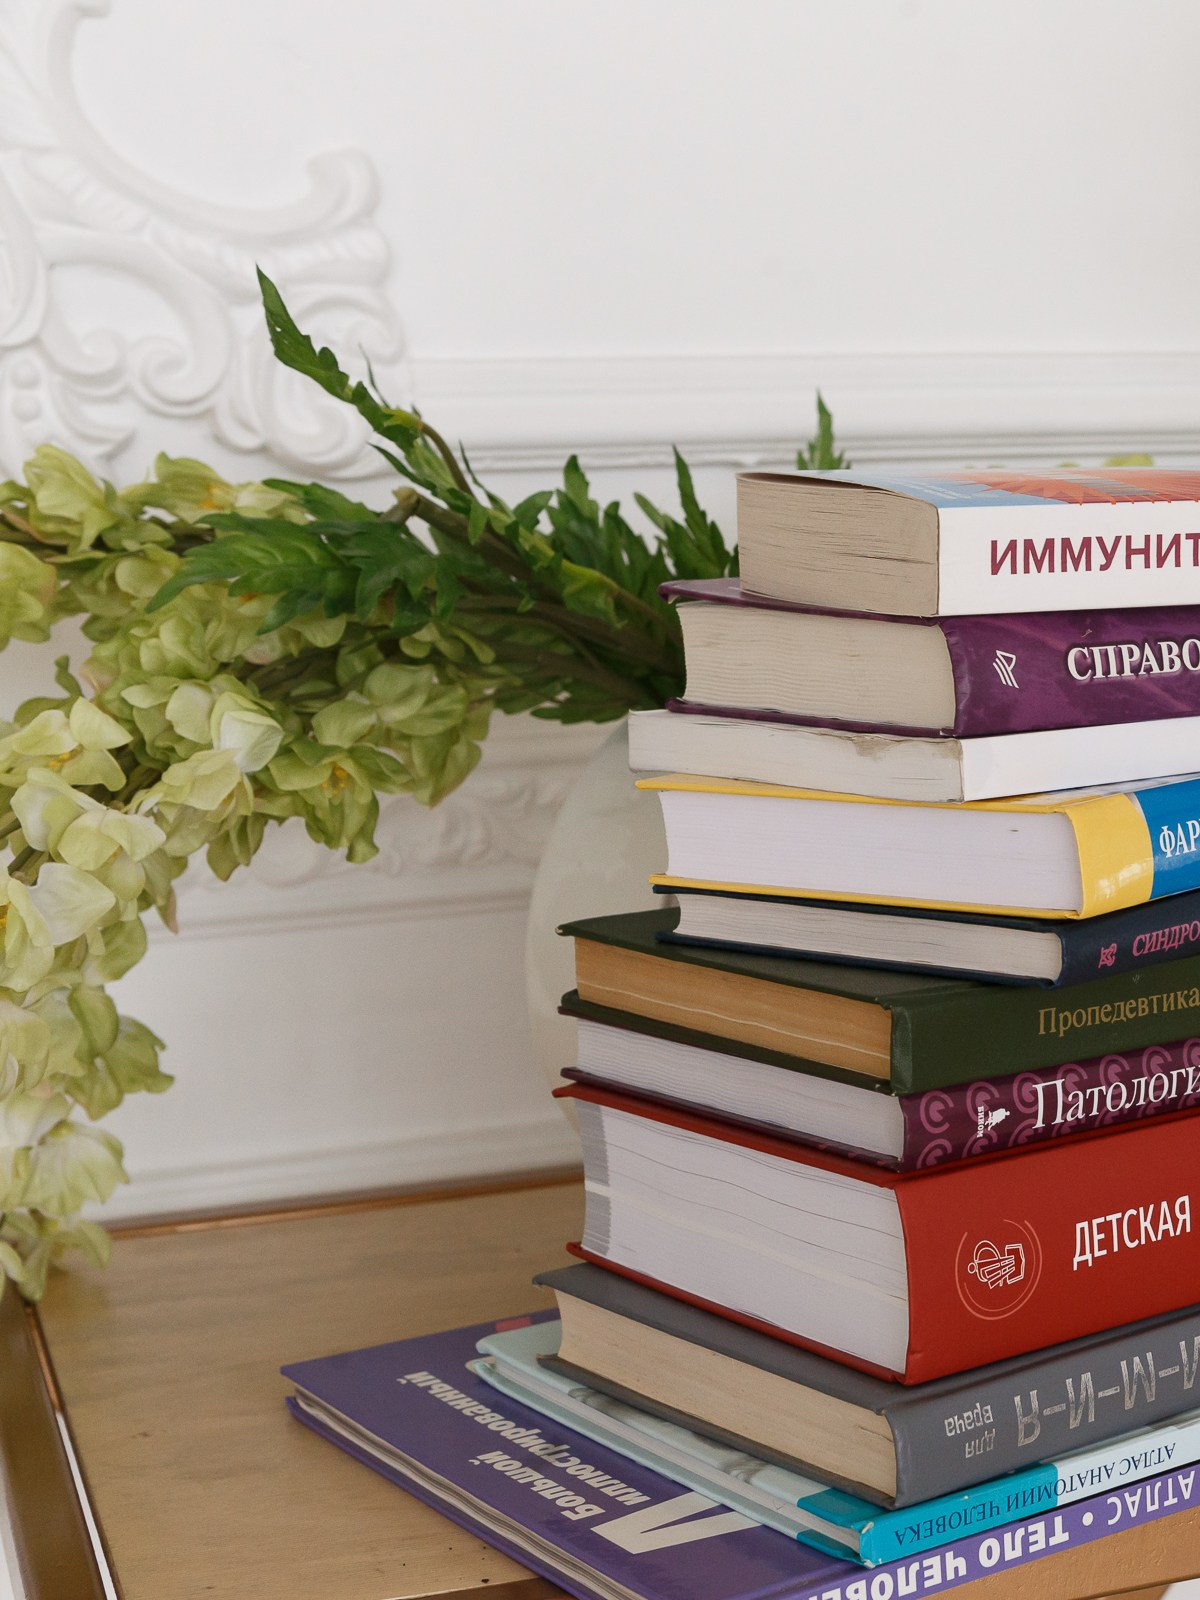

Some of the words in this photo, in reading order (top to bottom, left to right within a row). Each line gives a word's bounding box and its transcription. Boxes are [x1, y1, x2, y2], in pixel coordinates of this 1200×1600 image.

[1038, 986, 1200, 1038] Пропедевтика
[976, 1105, 985, 1138] БИНОМ
[1072, 1194, 1191, 1271] ДЕТСКАЯ
[396, 1370, 651, 1507] иллюстрированный
[944, 1403, 994, 1437] врача
[964, 1428, 996, 1459] для
[1119, 1442, 1176, 1476] АТЛАС
[468, 1450, 606, 1522] Большой
[1006, 1469, 1115, 1512] АНАТОМИИ
[1107, 1470, 1196, 1526] АТЛАС
[893, 1501, 1002, 1546] ЧЕЛОВЕКА
[978, 1515, 1070, 1568] ТЕЛО
[808, 1550, 968, 1600] ЧЕЛОВ
